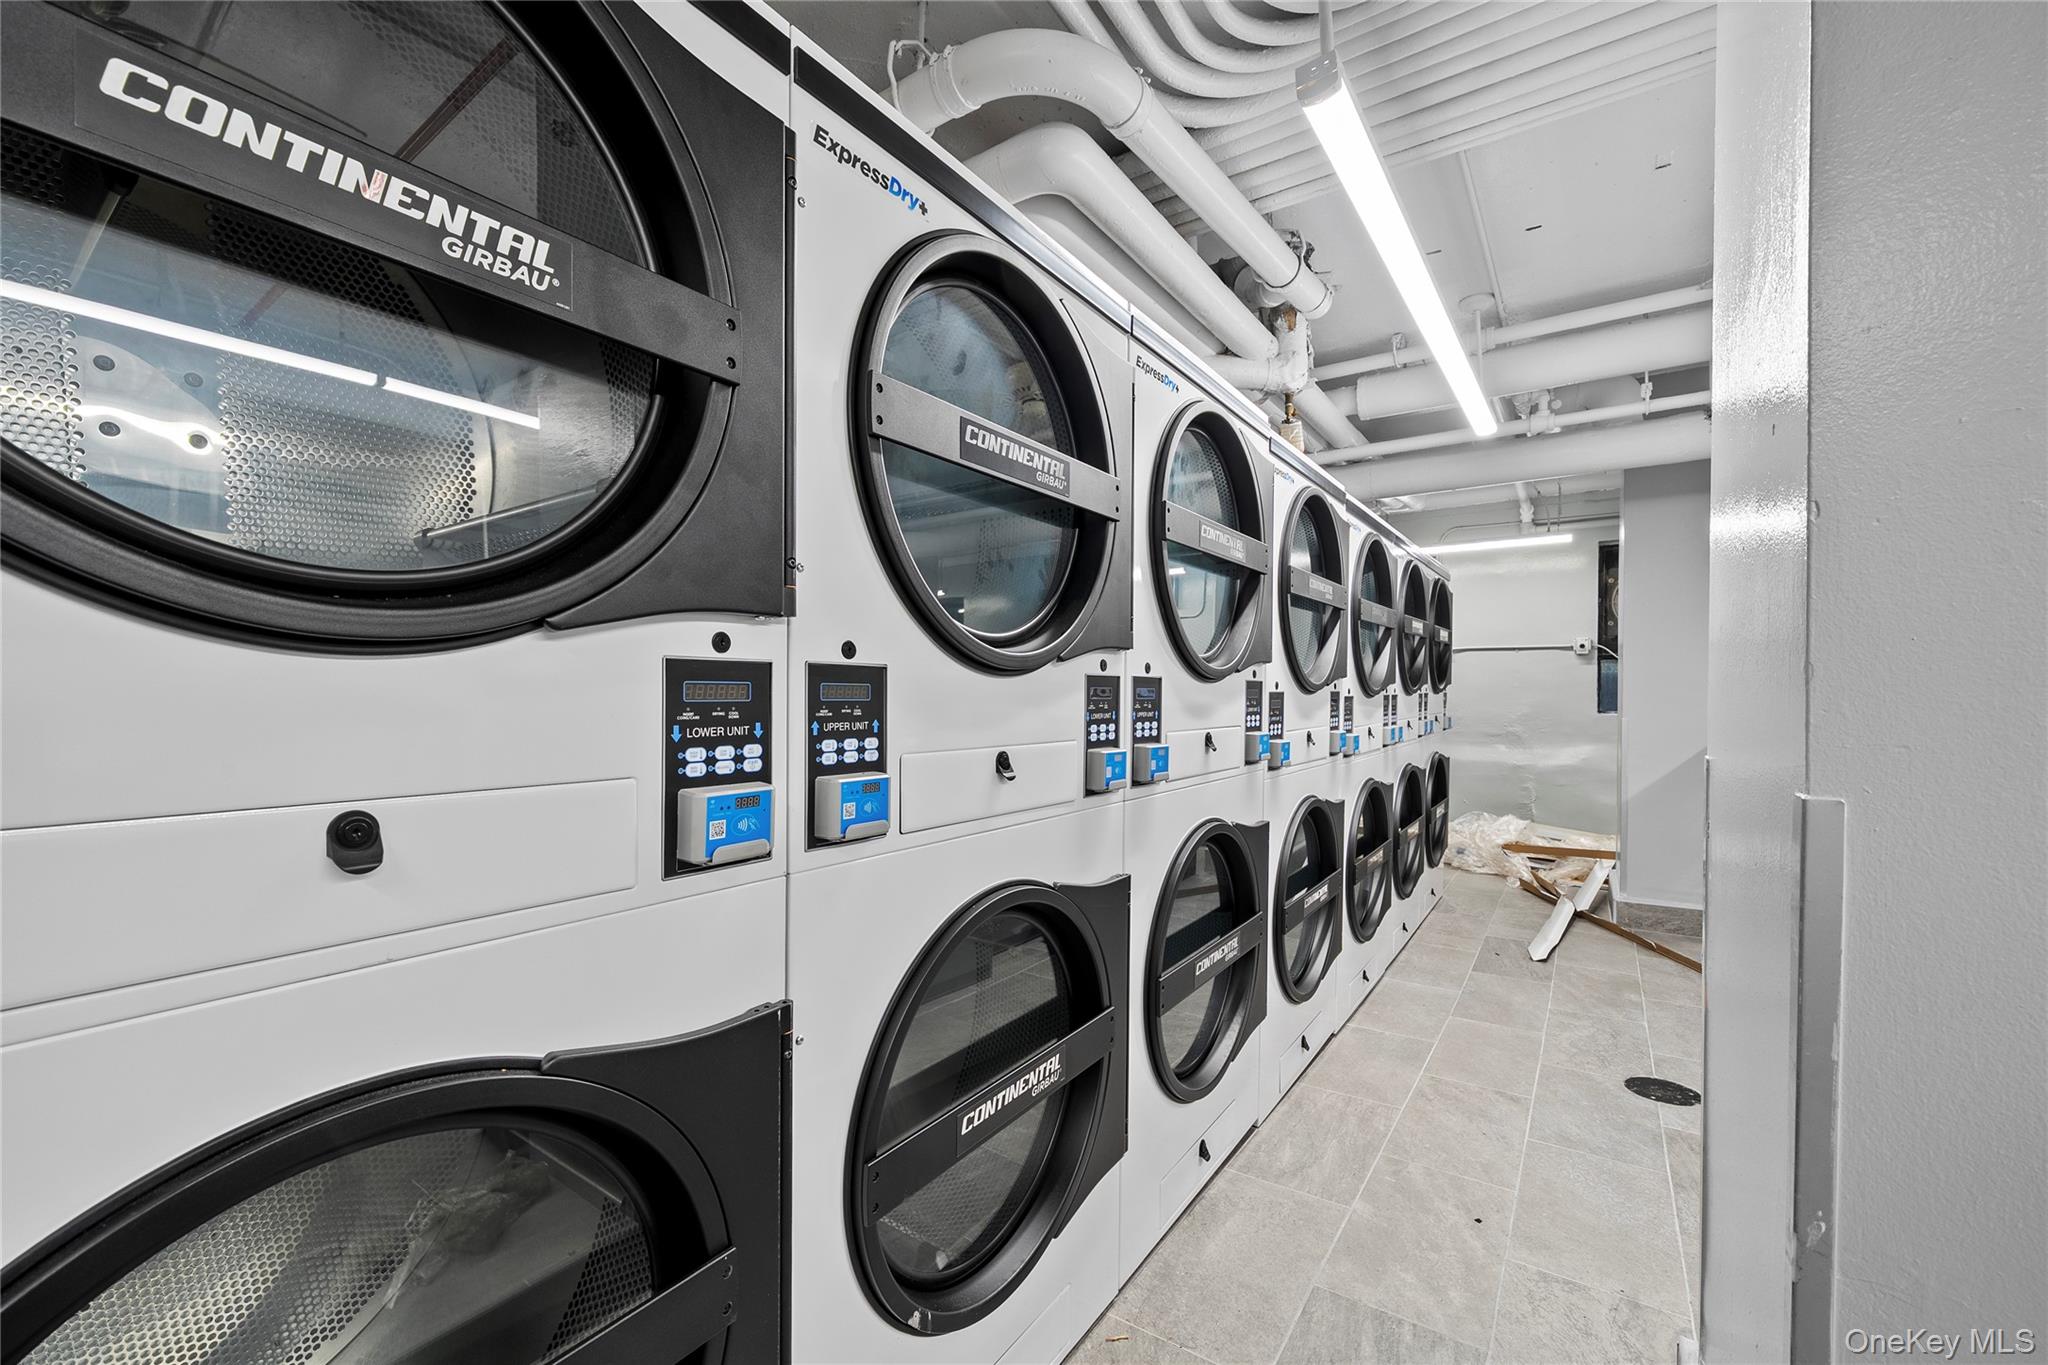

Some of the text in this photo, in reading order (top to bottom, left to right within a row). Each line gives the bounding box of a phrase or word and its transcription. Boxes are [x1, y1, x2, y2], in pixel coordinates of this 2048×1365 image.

[98, 56, 556, 274] CONTINENTAL
[964, 424, 1066, 480] CONTINENTAL
[686, 725, 750, 738] LOWER UNIT
[823, 721, 870, 732] UPPER UNIT
[1195, 936, 1240, 976] CONTINENTAL
[960, 1052, 1063, 1137] CONTINENTAL
